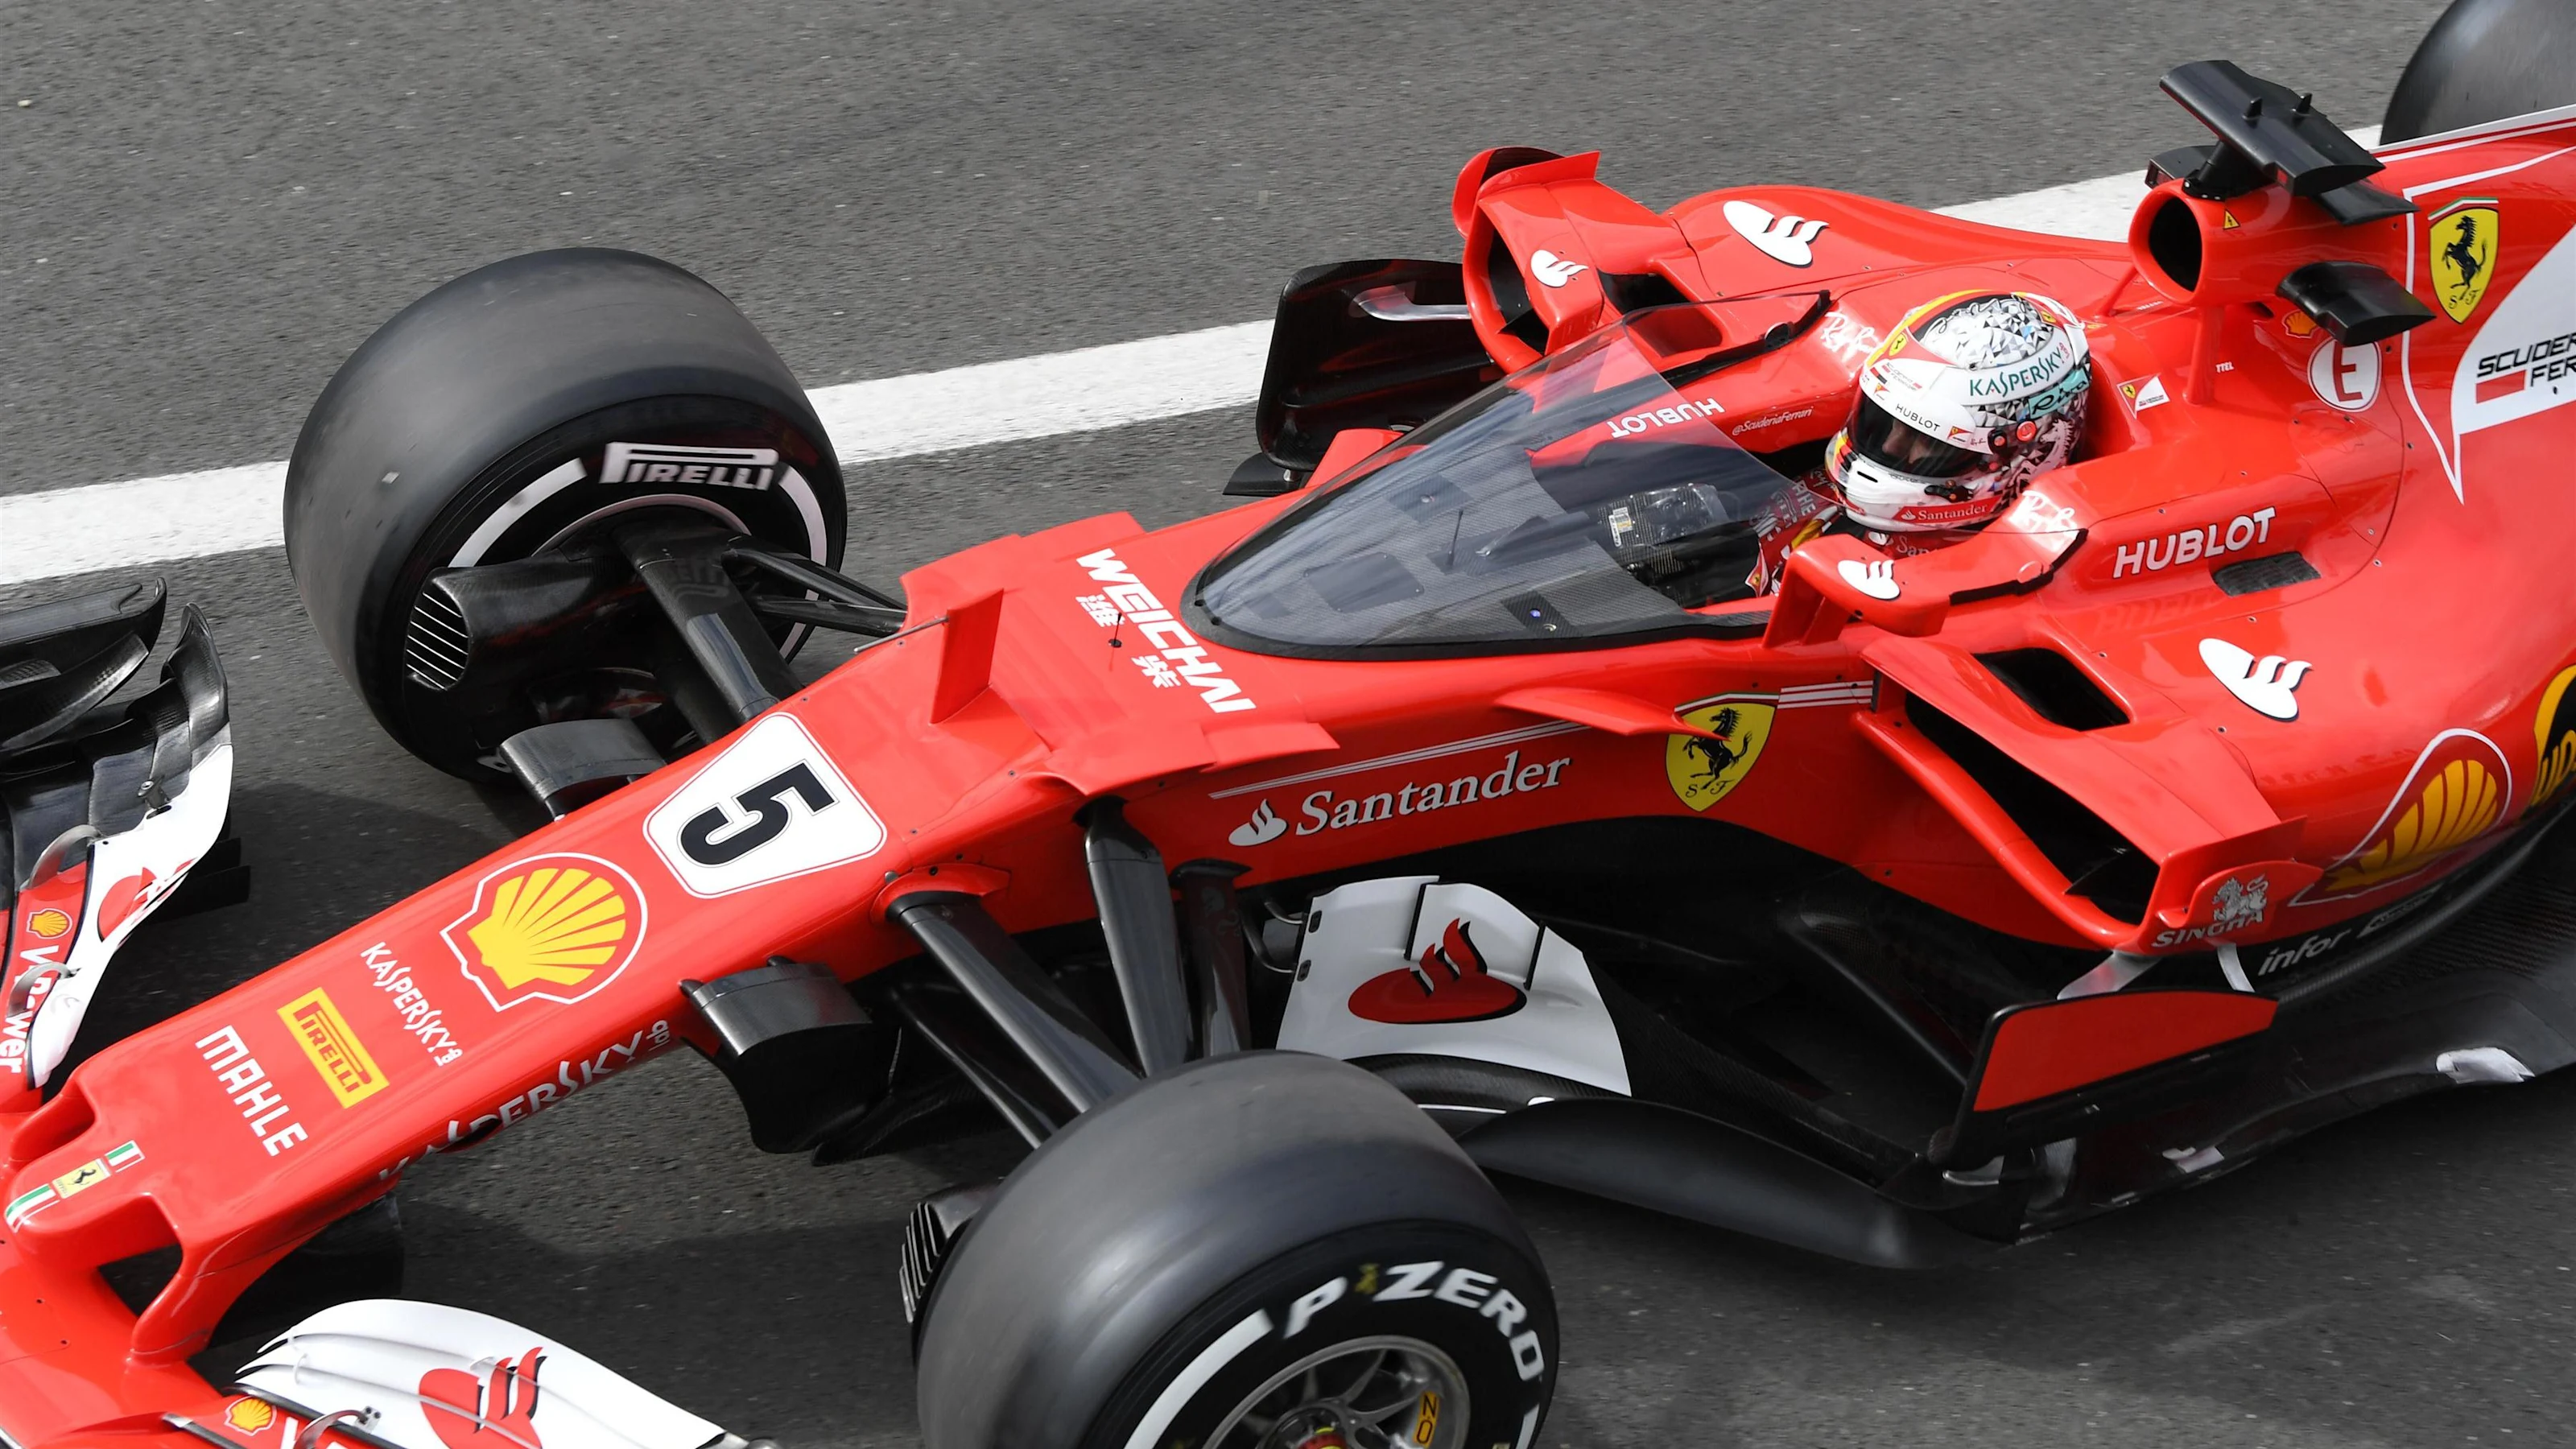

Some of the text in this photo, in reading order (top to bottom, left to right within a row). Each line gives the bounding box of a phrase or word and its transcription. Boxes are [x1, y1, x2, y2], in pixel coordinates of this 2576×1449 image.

[1969, 346, 2064, 398] KASPERSKY
[2032, 380, 2087, 415] Riva
[1606, 398, 1726, 439] HUBLOT
[1732, 408, 1813, 436] @ScuderiaFerrari
[1895, 403, 1941, 433] HUBLOT
[598, 442, 779, 491] PIRELLI
[1918, 505, 1988, 521] Santander
[2112, 507, 2276, 579] HUBLOT
[1075, 548, 1257, 713] WEICHAI
[679, 762, 838, 866] 5
[1295, 750, 1571, 836] Santander
[2151, 910, 2264, 947] SINGHA
[2258, 928, 2352, 976] infor
[360, 941, 464, 1067] KASPERSKY lab
[293, 1000, 373, 1093] PIRELLI
[194, 1026, 309, 1157] MAHLE
[1284, 1261, 1546, 1381] P ZERO
